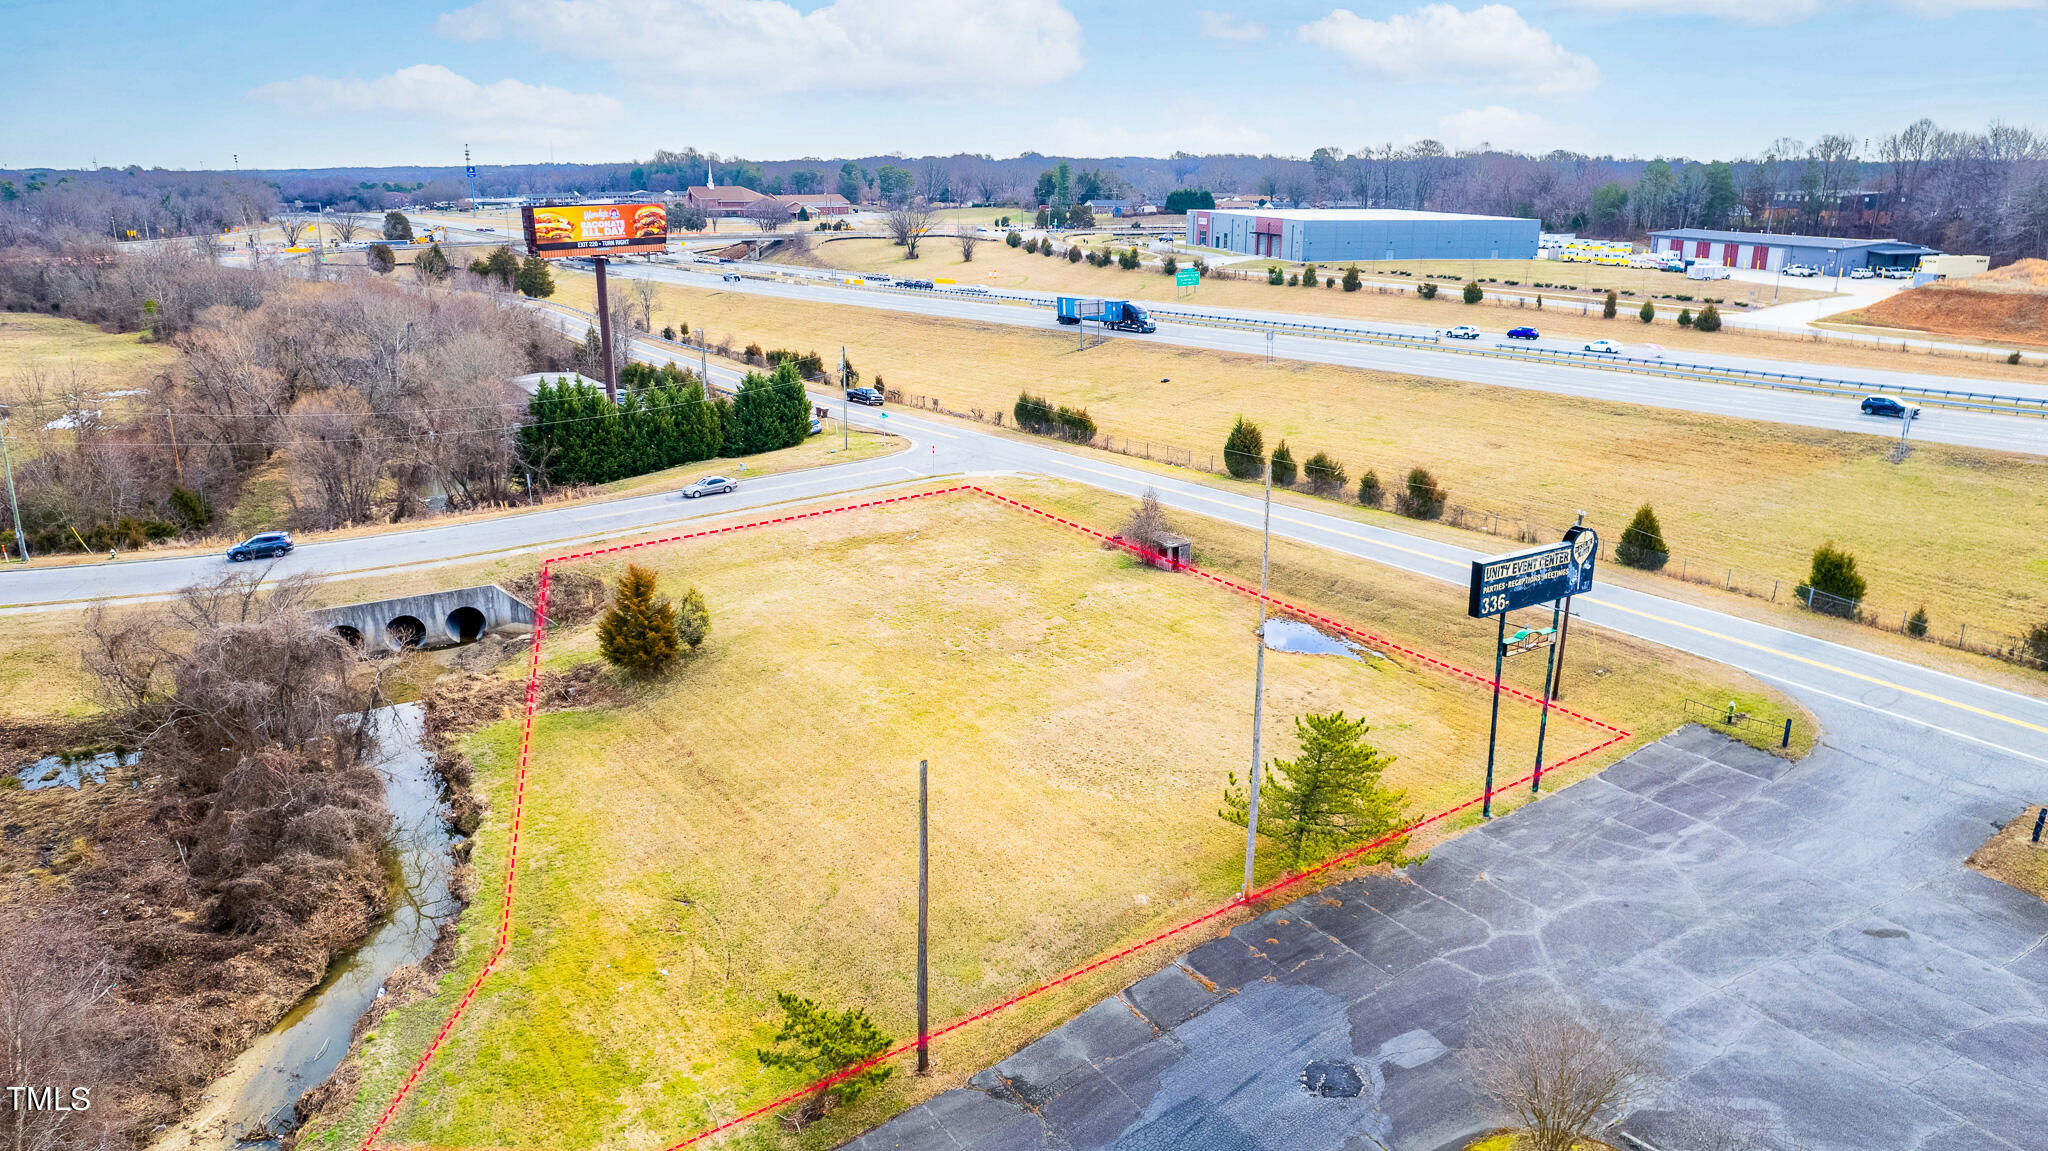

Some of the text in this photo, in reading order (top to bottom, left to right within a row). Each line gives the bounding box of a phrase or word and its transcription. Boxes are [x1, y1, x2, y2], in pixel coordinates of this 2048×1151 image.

[581, 220, 625, 229] BACONATE
[1486, 563, 1511, 580] UNITY
[1512, 558, 1538, 575] EVENT
[1483, 568, 1569, 595] PARTIES RECEPTIONS MEETINGS
